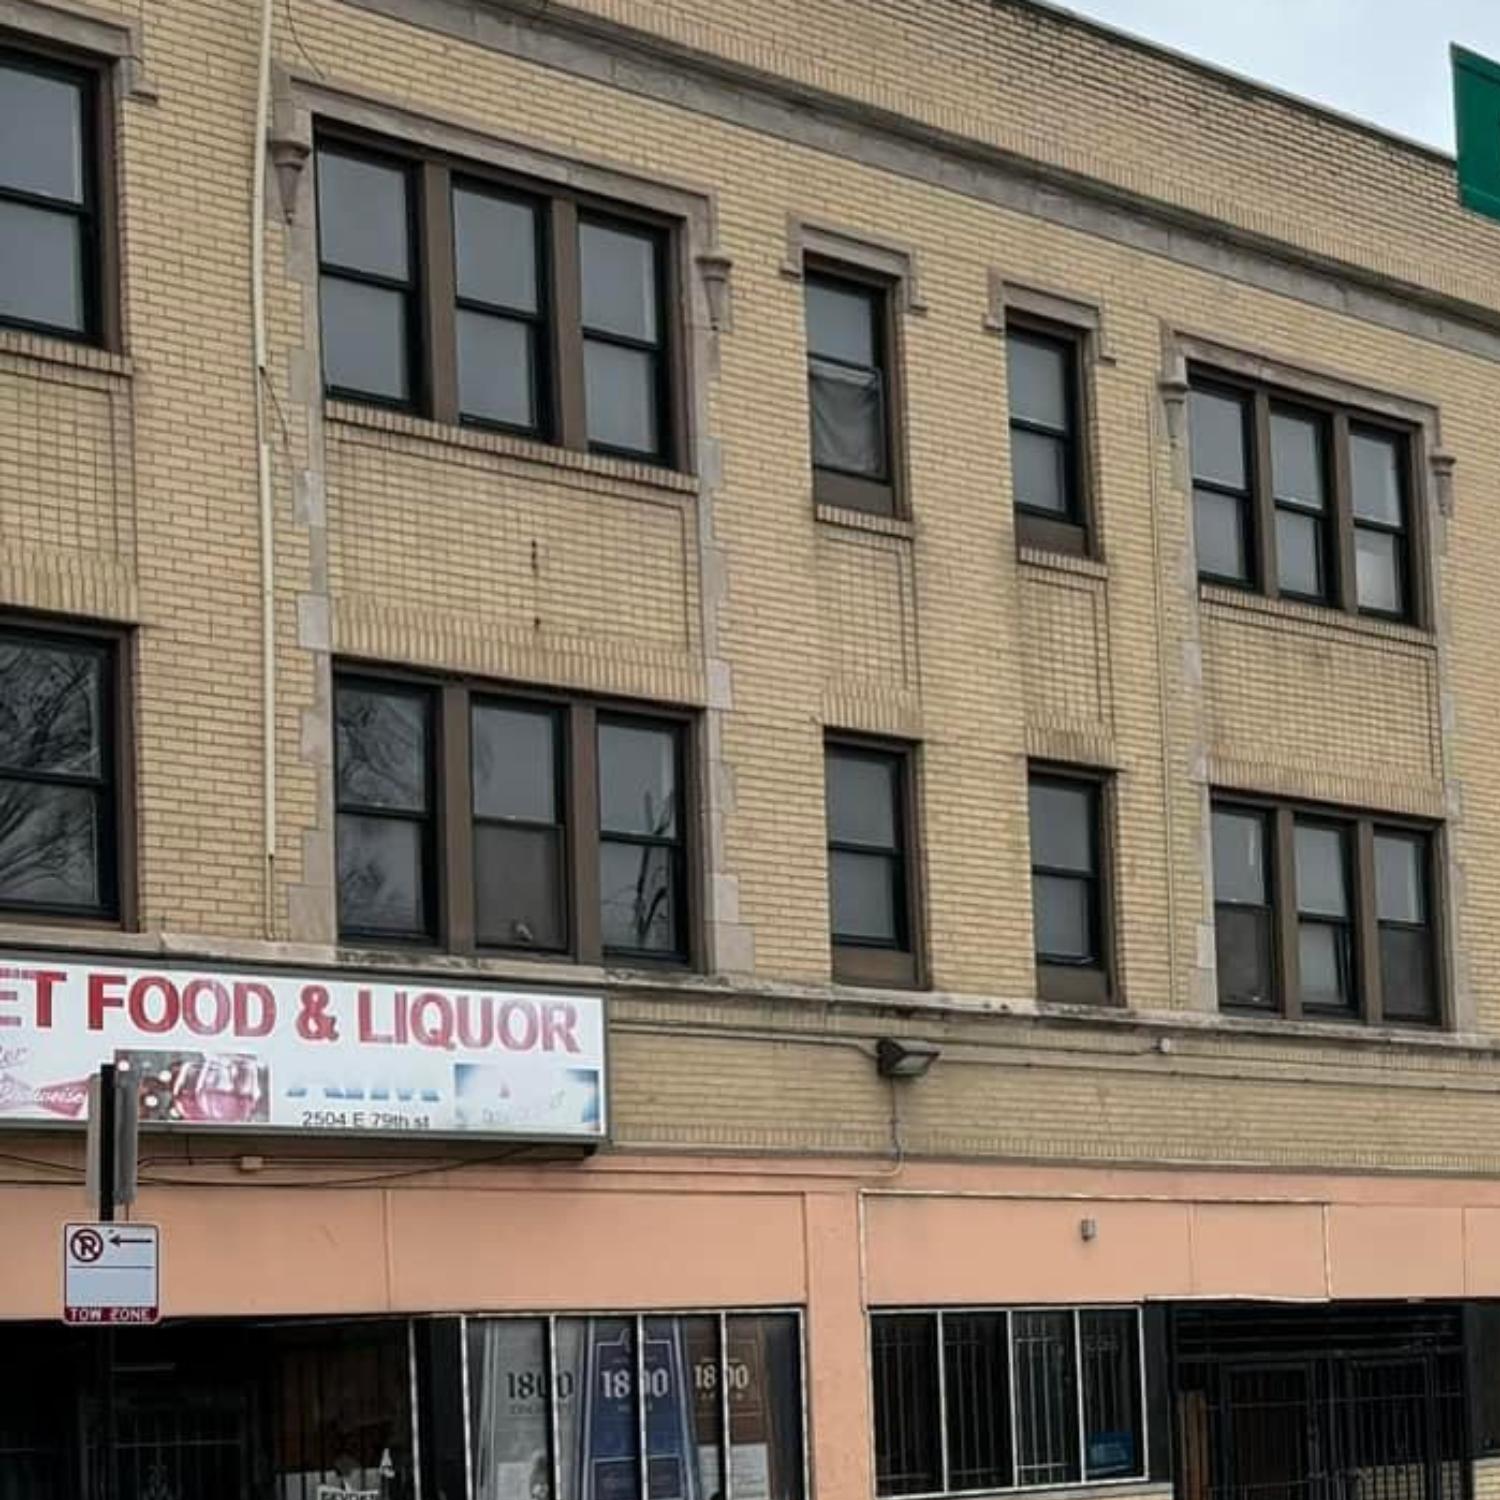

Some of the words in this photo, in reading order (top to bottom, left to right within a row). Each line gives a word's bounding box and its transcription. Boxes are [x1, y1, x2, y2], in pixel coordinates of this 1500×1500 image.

[87, 973, 278, 1037] FOOD
[296, 984, 340, 1042] &
[357, 988, 581, 1054] LIQUOR
[302, 1110, 347, 1129] 2504
[353, 1111, 365, 1129] E
[371, 1112, 409, 1129] 79th
[70, 1308, 102, 1322] TOW
[110, 1308, 153, 1322] ZONE
